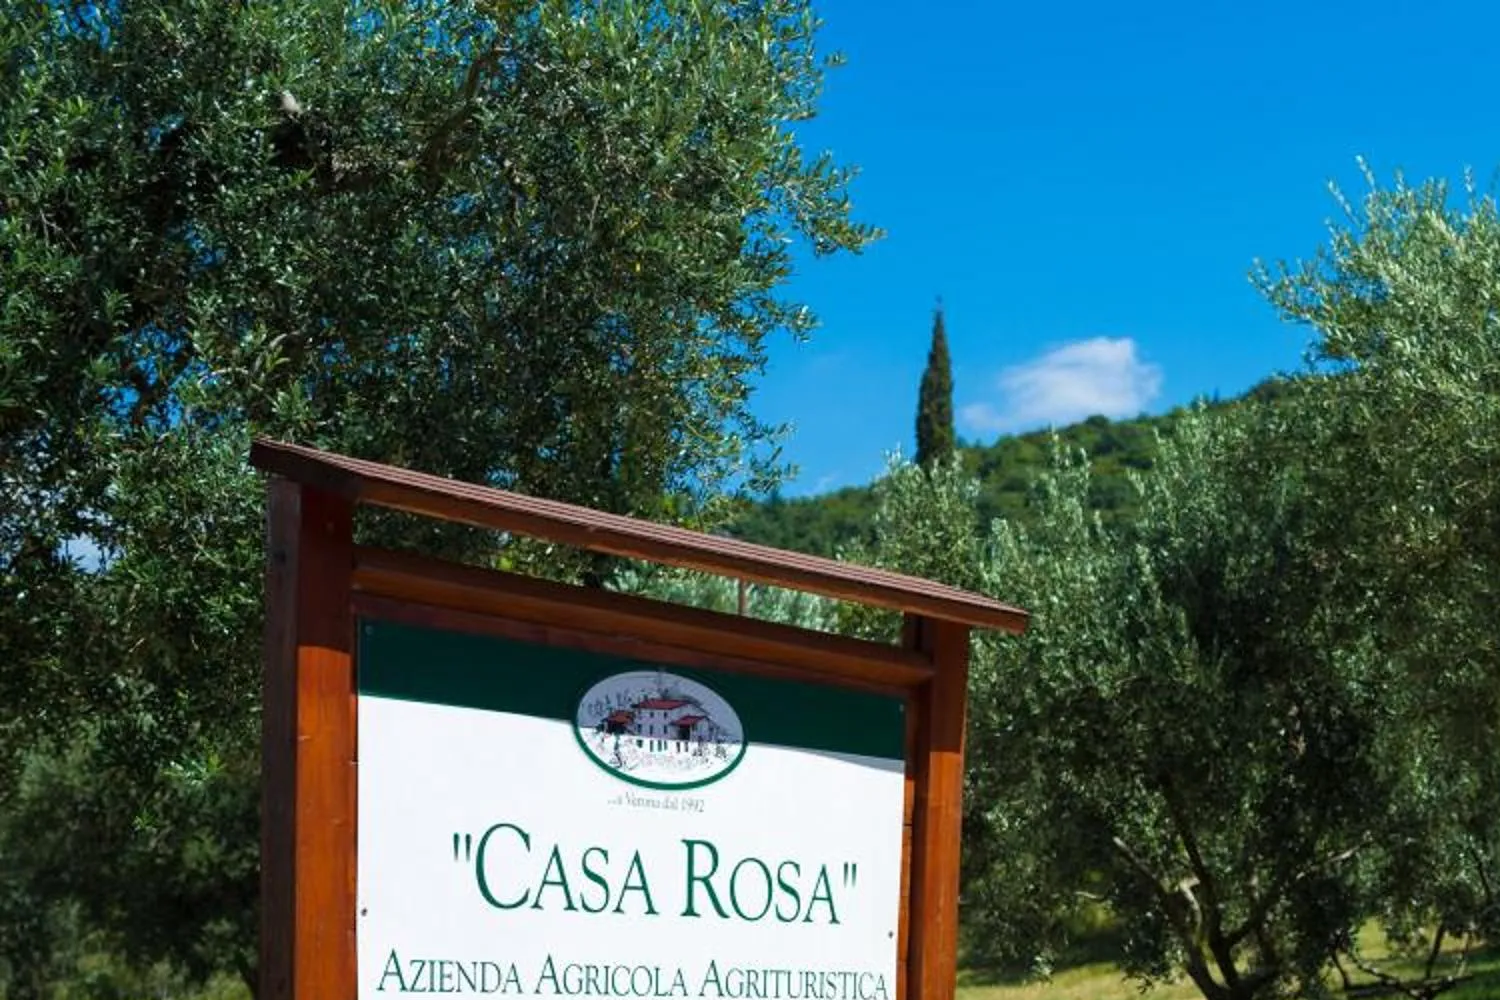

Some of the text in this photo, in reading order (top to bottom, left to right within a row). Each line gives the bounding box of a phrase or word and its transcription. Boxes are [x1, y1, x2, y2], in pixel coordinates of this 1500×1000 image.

[452, 823, 858, 925] "CASA ROSA"
[376, 948, 889, 1000] AZIENDA AGRICOLA AGRITURISTICA
